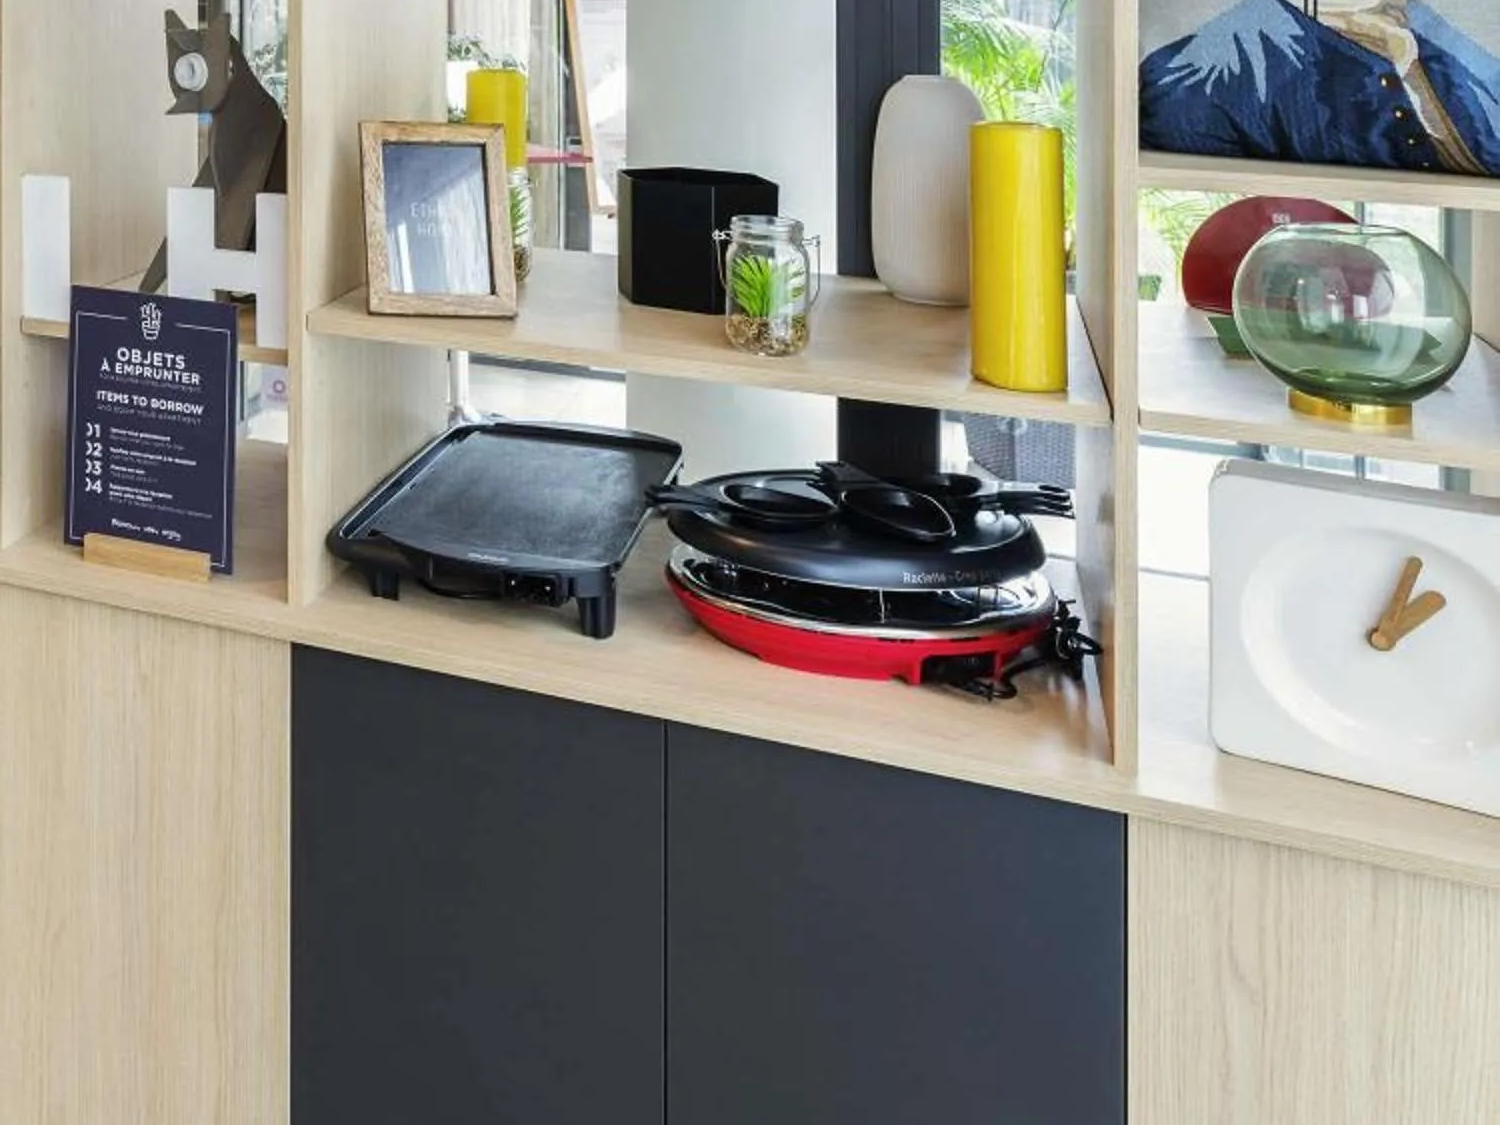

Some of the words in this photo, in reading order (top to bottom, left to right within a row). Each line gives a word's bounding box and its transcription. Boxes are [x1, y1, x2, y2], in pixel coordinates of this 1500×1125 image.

[116, 346, 186, 370] OBJETS
[115, 361, 201, 386] EMPRUNTER
[96, 389, 130, 404] ITEMS
[131, 394, 149, 407] TO
[150, 397, 204, 416] BORROW
